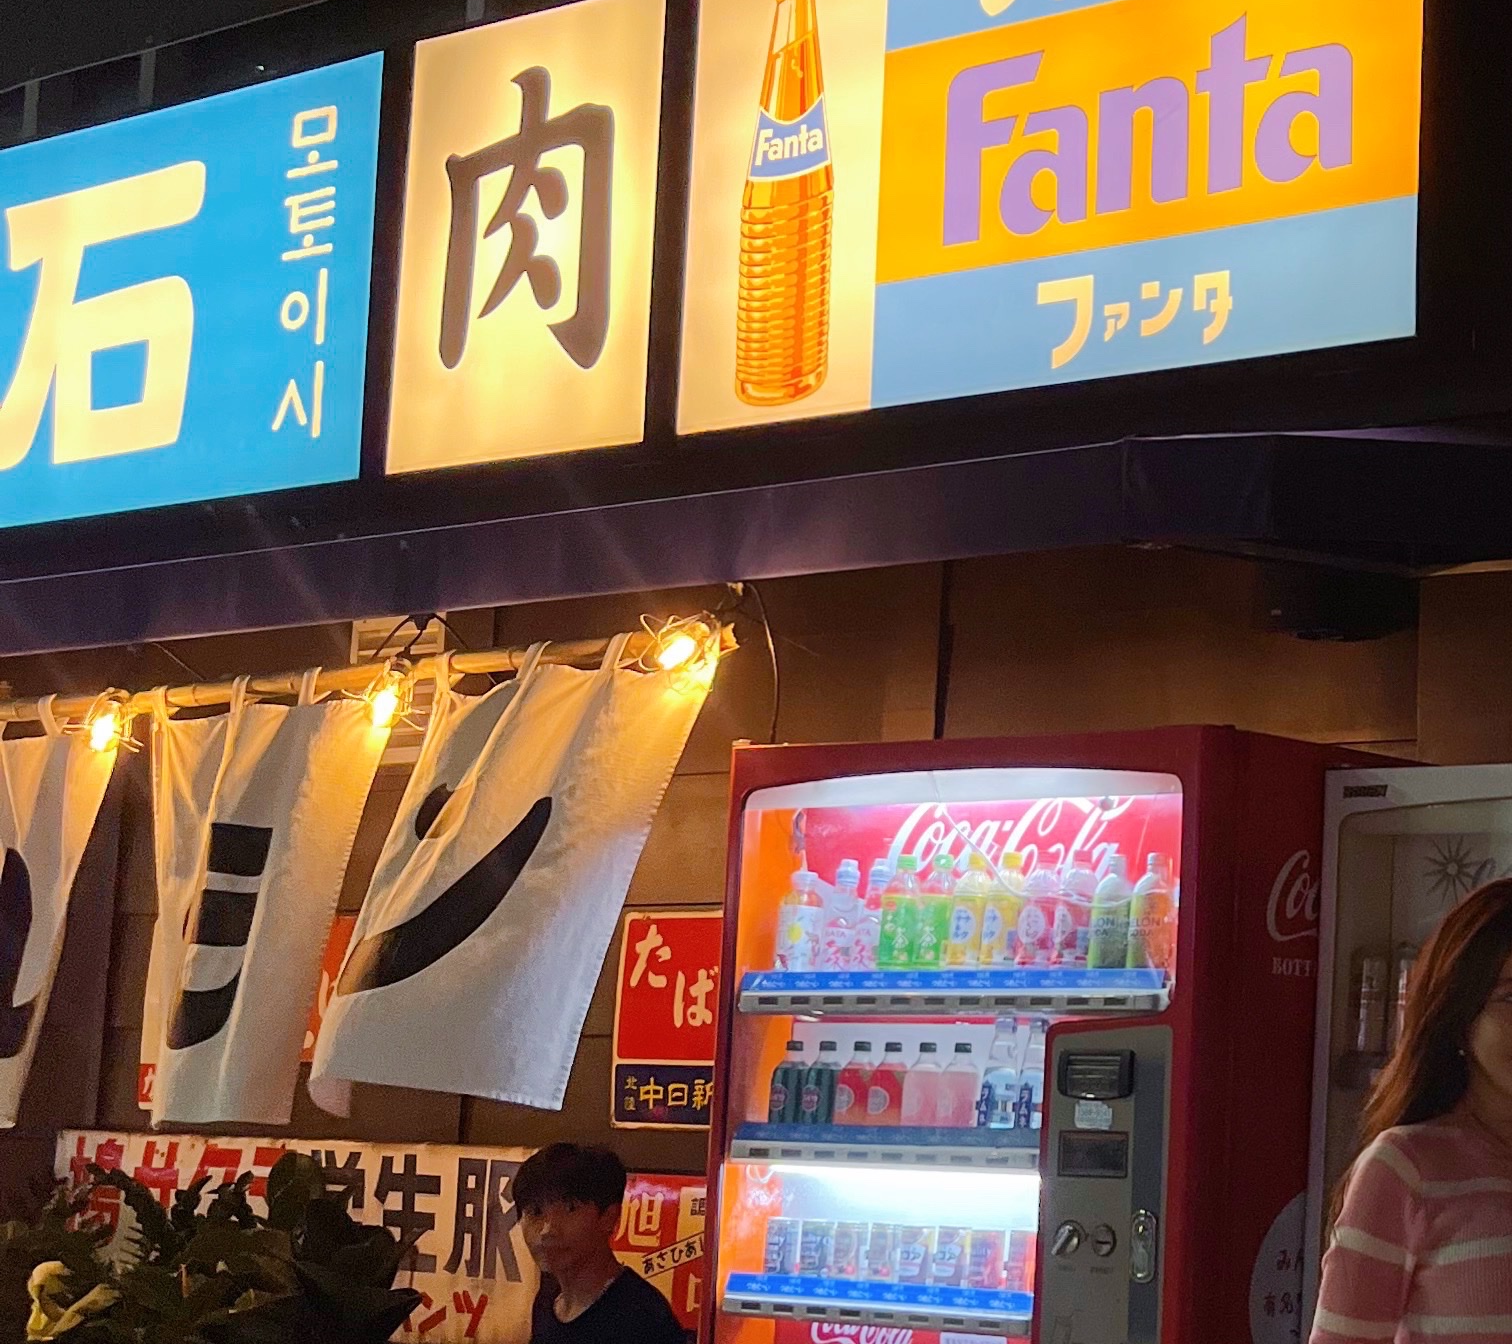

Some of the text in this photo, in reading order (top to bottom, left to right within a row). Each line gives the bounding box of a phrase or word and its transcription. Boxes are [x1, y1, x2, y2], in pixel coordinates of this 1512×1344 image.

[754, 122, 826, 167] Fanta
[942, 11, 1354, 247] Fanta
[272, 104, 338, 439] 모토이시
[438, 65, 615, 370] 肉
[1037, 269, 1233, 369] ファンタ
[630, 924, 719, 1029] たば
